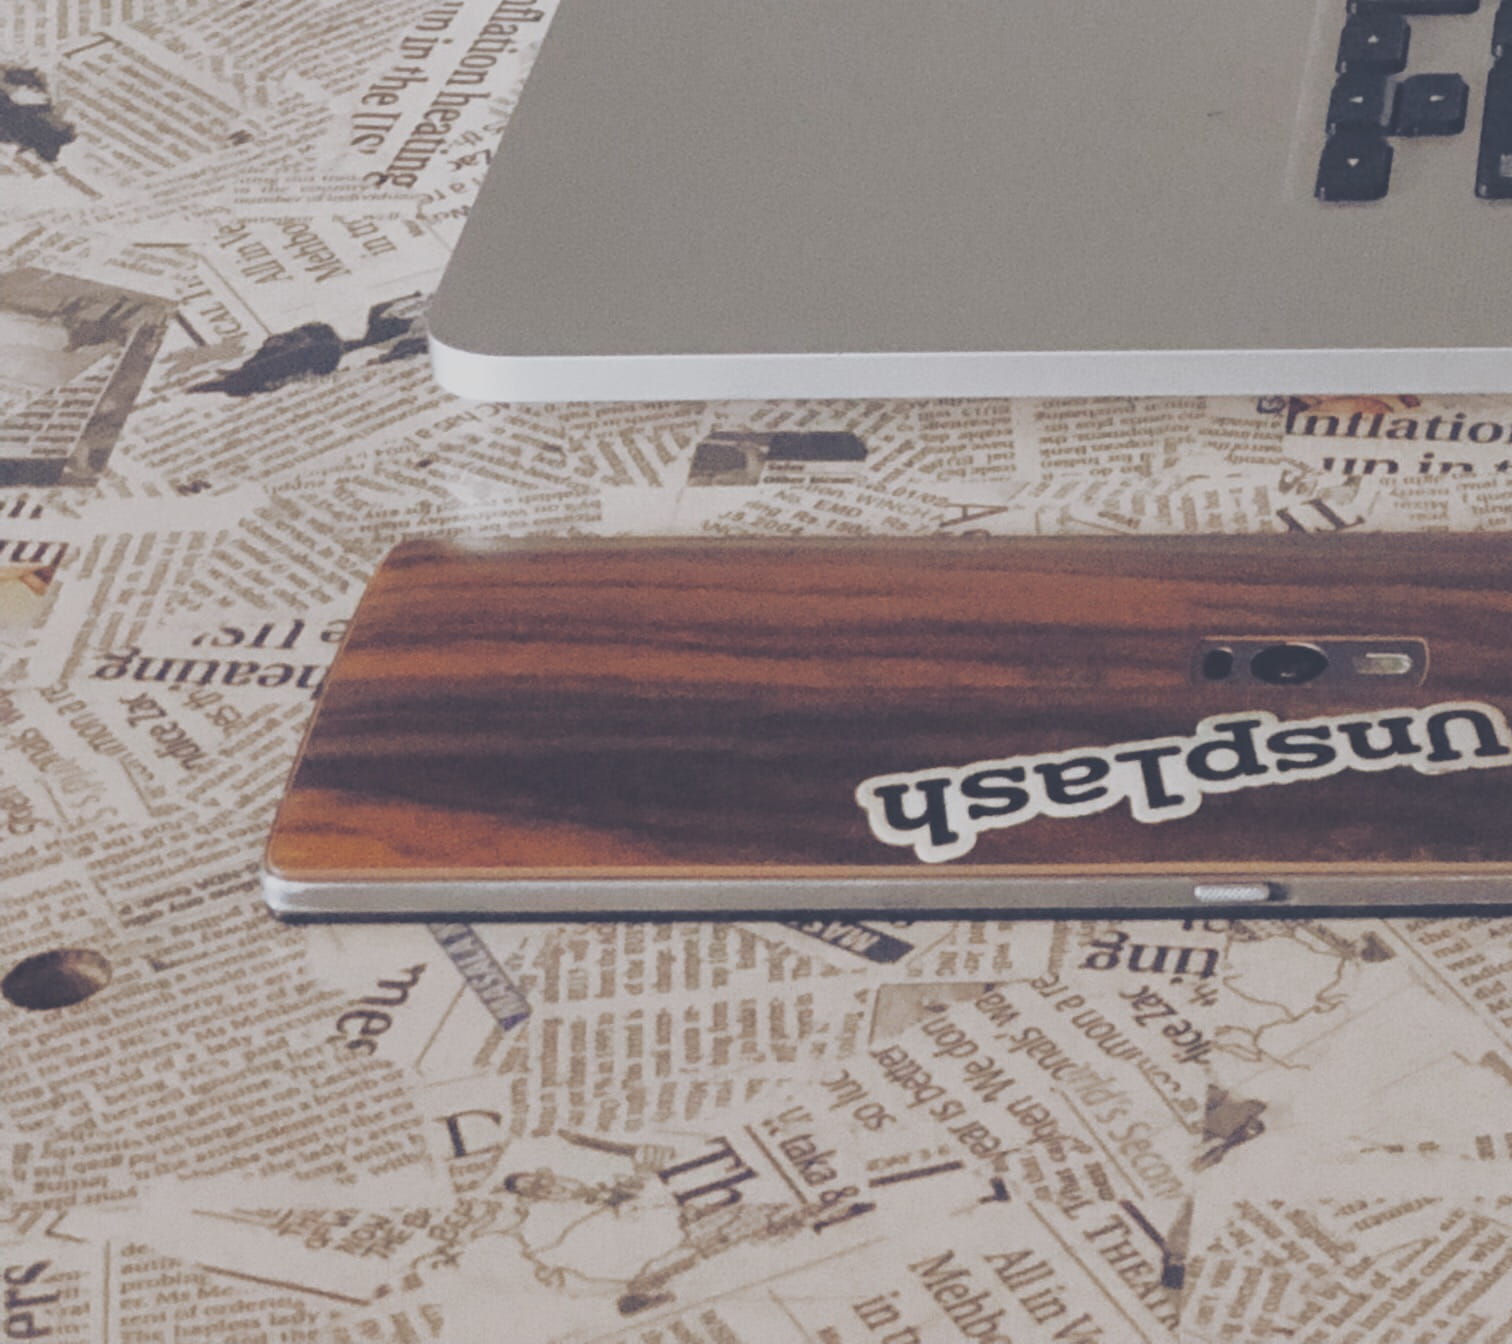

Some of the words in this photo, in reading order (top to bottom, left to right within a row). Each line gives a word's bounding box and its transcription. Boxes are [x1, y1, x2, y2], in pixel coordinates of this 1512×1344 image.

[367, 93, 490, 190] heating
[873, 708, 1509, 847] Unsplash
[867, 1039, 944, 1109] better
[778, 1133, 837, 1188] taka
[982, 1250, 1055, 1293] All
